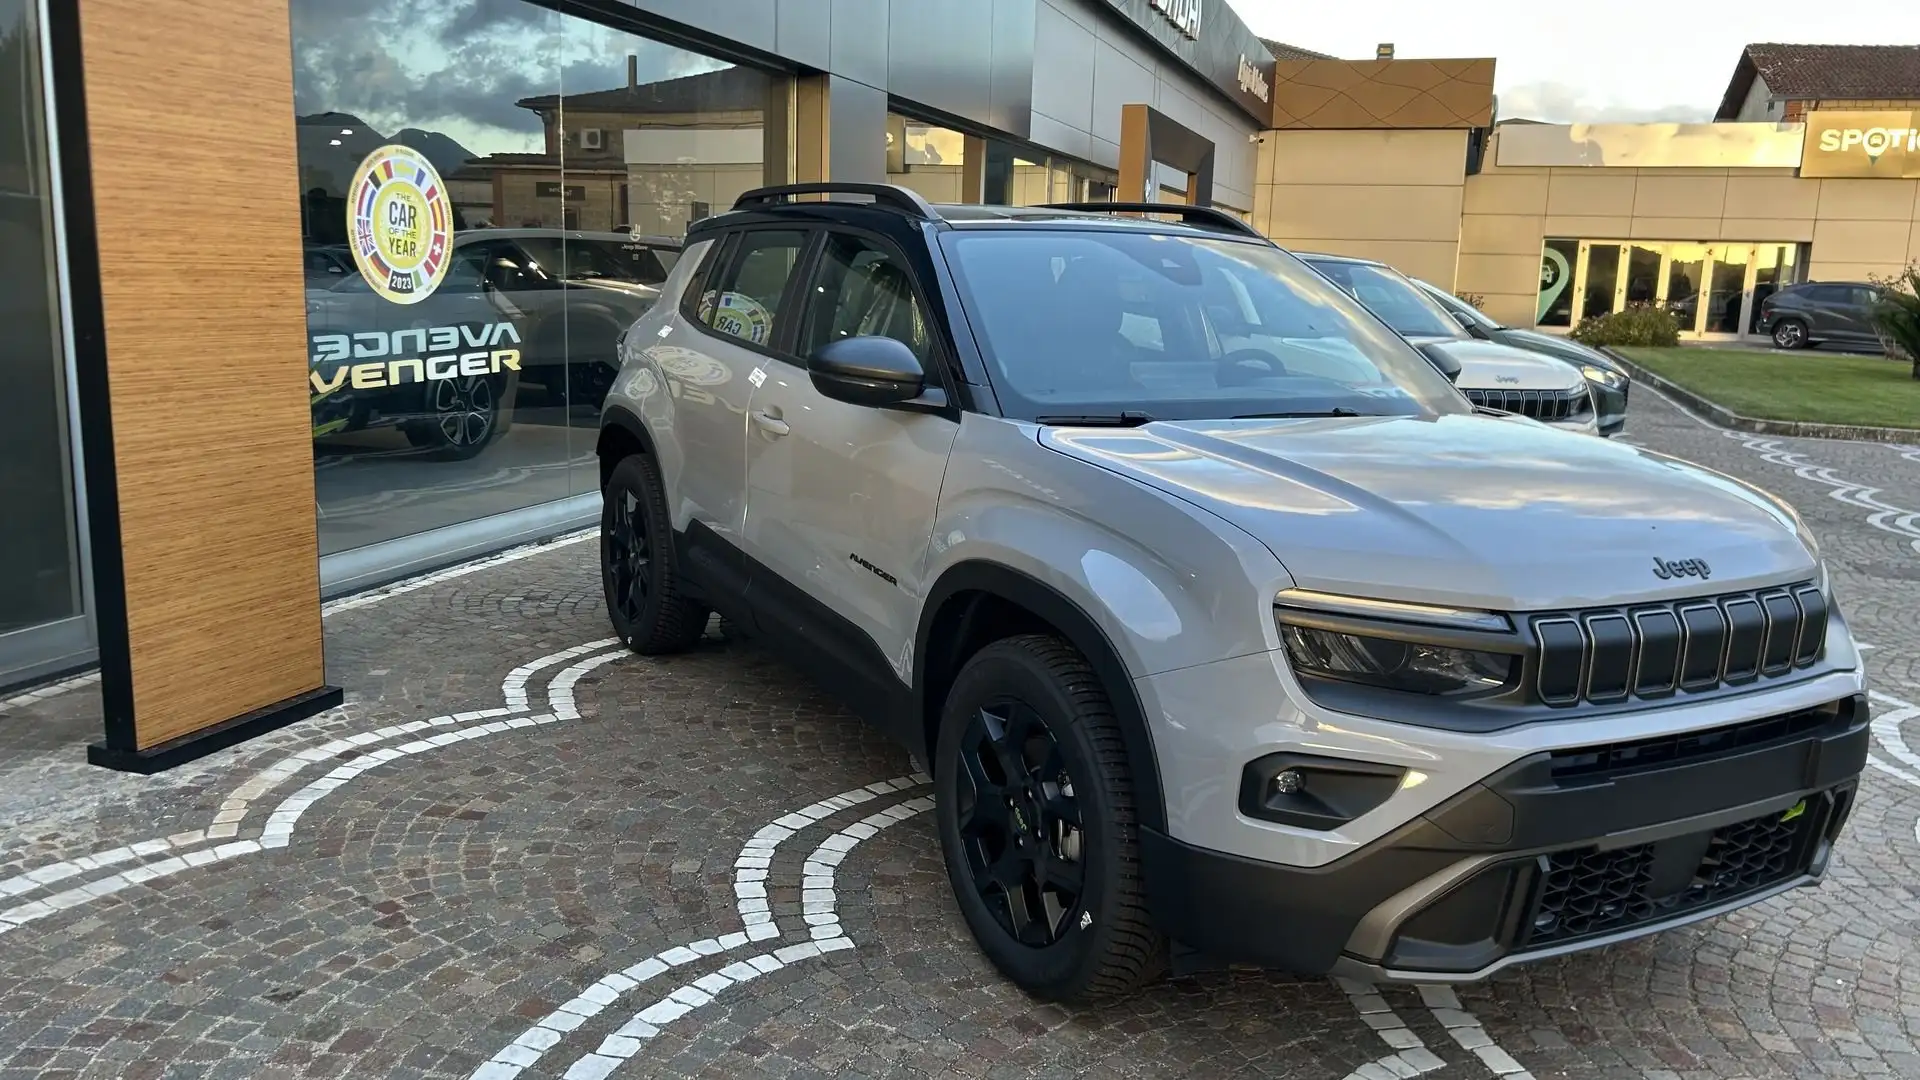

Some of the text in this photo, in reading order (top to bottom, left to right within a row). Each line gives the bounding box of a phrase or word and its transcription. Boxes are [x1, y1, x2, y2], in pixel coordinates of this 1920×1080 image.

[396, 193, 411, 201] THE
[389, 201, 417, 229] CAR
[388, 227, 417, 239] OF THE
[388, 236, 417, 258] YEAR
[391, 276, 412, 289] 2023
[310, 349, 522, 394] VENGER
[1652, 556, 1711, 580] Jeep
